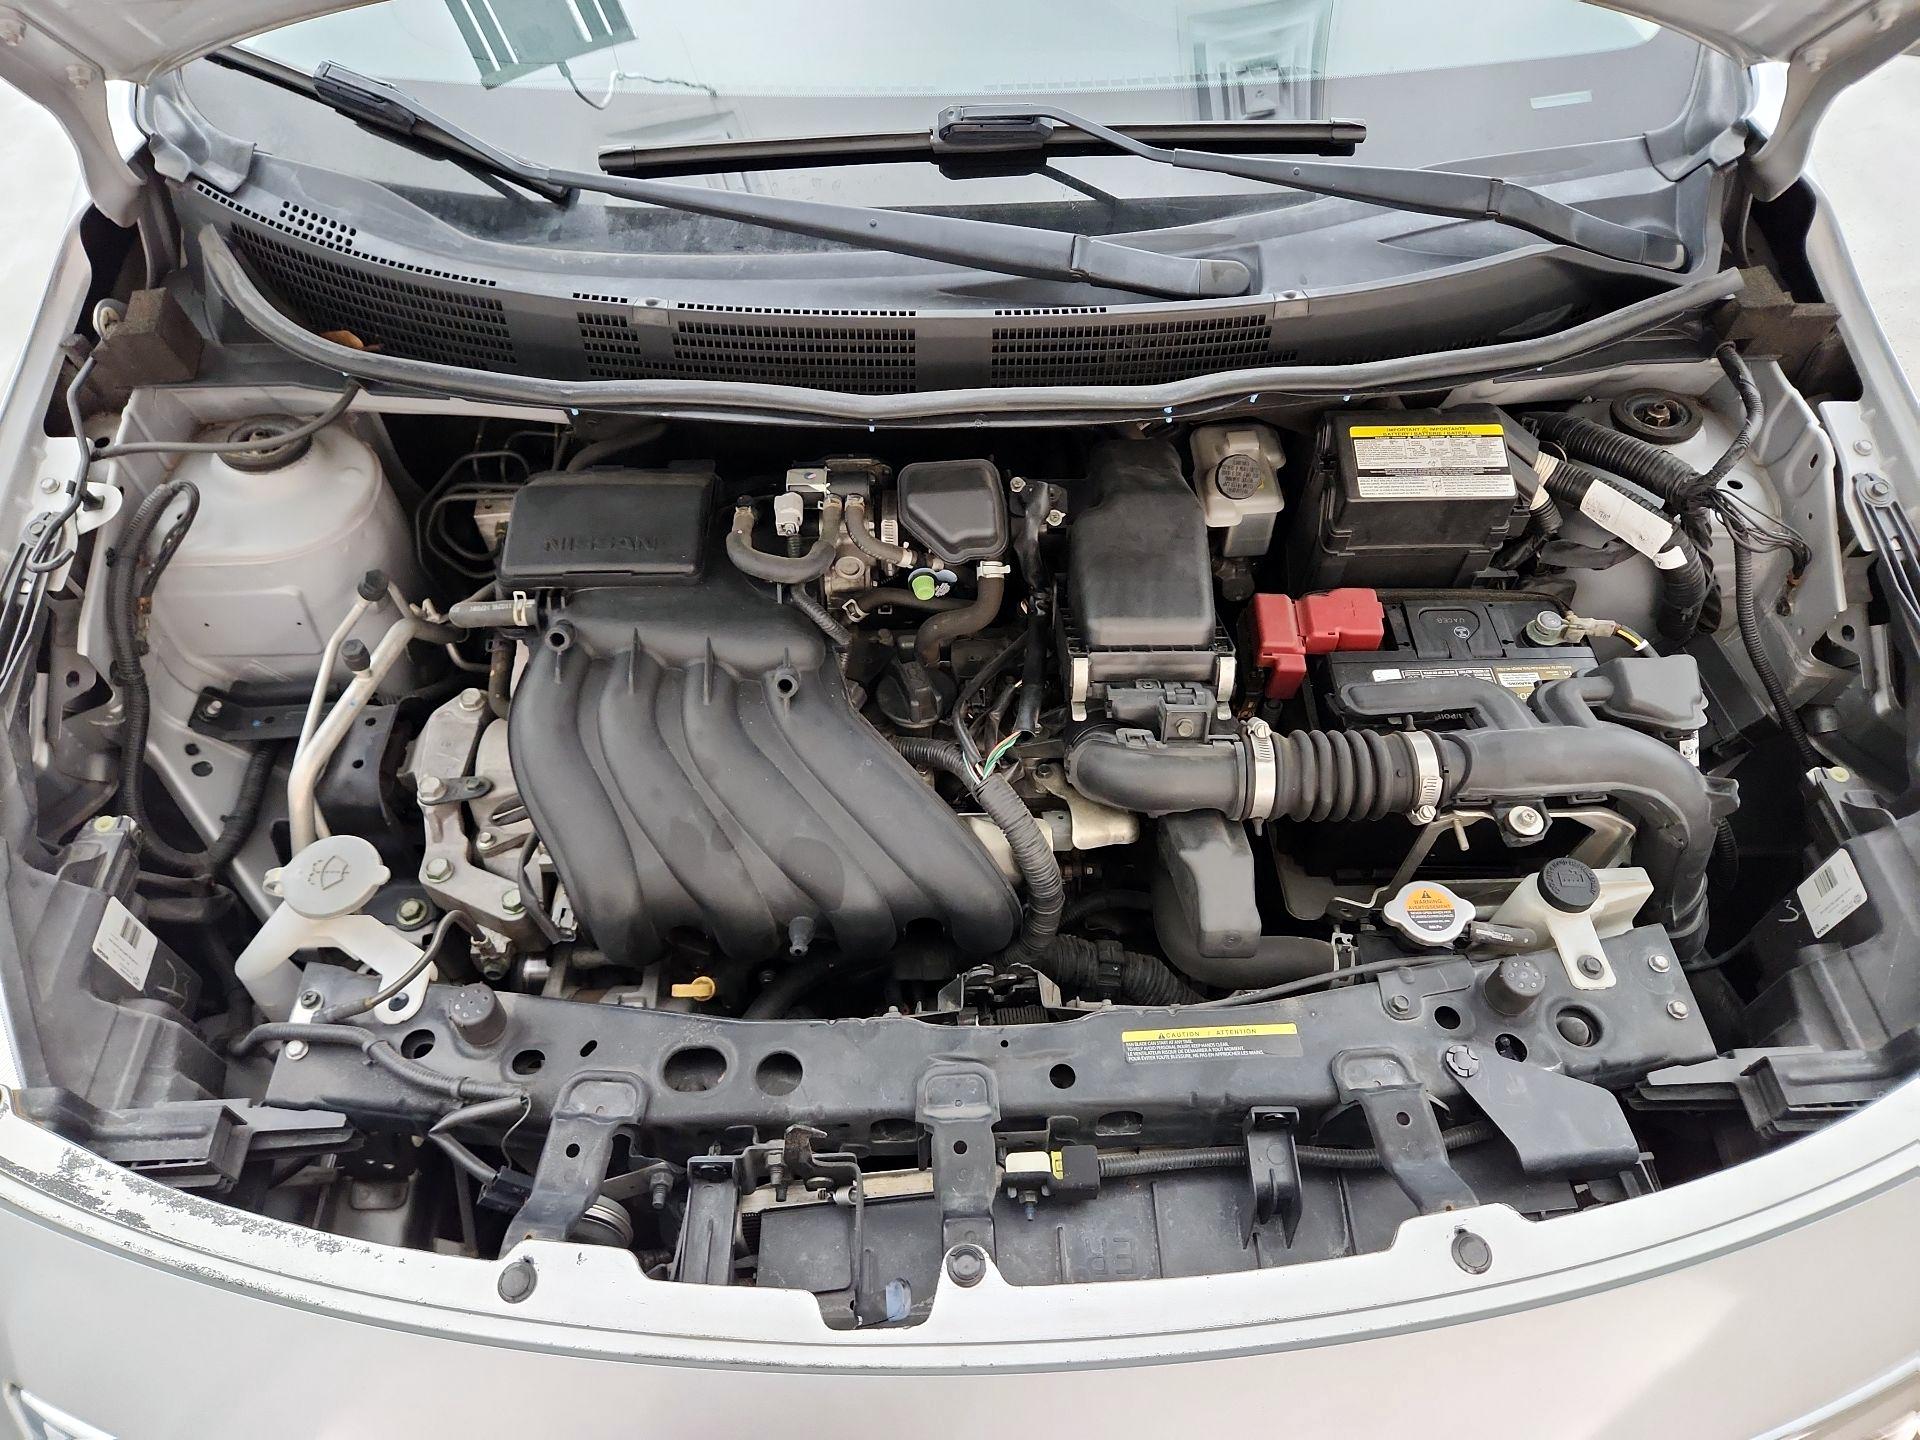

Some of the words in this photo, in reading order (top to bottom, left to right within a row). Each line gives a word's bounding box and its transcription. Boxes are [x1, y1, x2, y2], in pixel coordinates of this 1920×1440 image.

[546, 535, 658, 552] NISSAN
[1778, 899, 1799, 922] 3
[1165, 1031, 1200, 1039] CAUTION
[1216, 1028, 1257, 1036] ATTENTION
